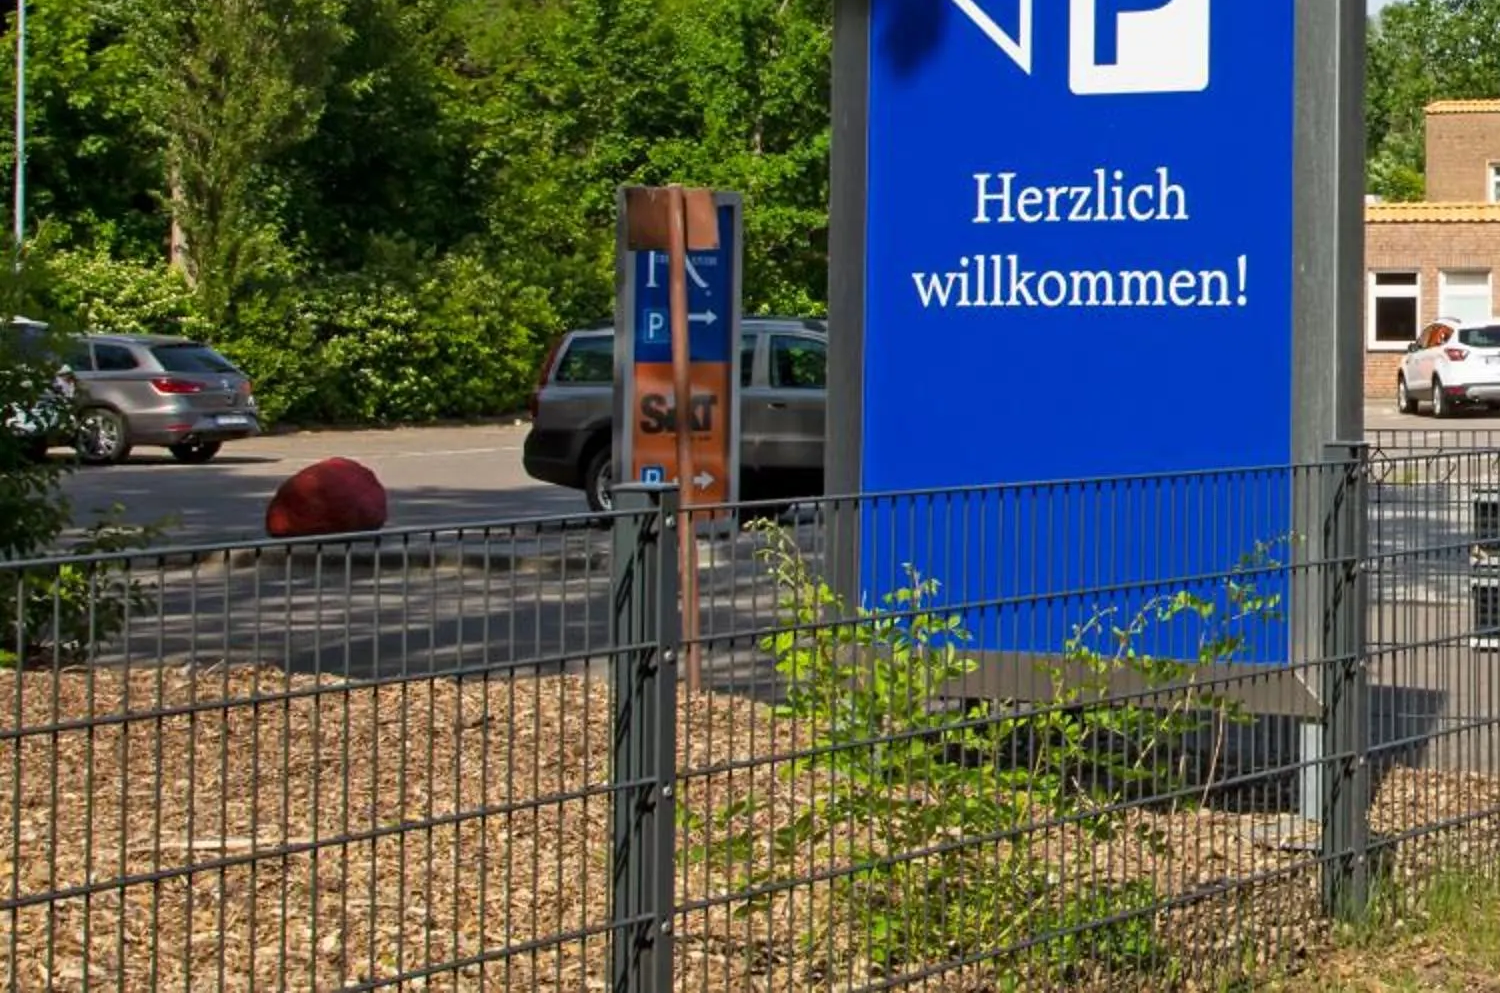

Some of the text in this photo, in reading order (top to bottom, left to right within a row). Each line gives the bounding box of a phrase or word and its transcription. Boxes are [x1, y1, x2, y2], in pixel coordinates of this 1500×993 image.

[971, 167, 1190, 224] Herzlich
[912, 254, 1249, 308] willkommen!
[648, 312, 664, 340] P
